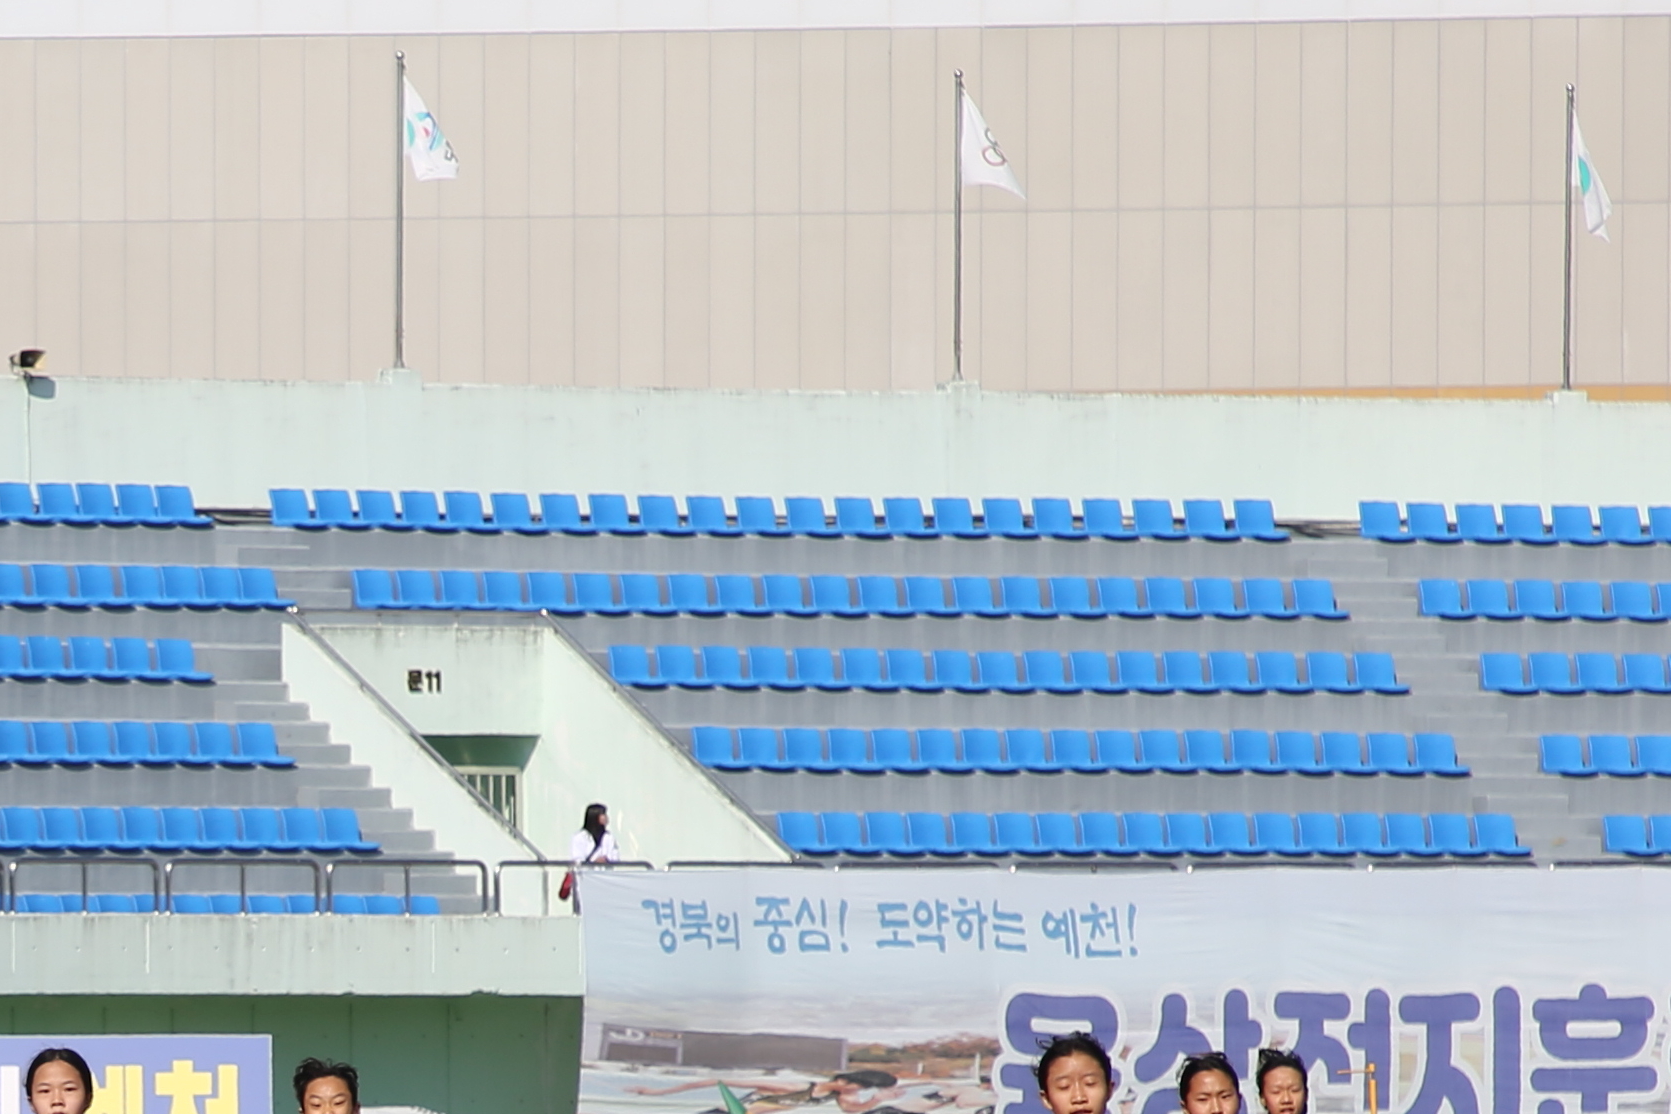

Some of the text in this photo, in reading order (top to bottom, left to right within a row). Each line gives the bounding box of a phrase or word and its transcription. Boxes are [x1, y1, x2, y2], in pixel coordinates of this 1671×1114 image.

[642, 896, 1138, 959] 경북의 중심! 도약하는 예천!
